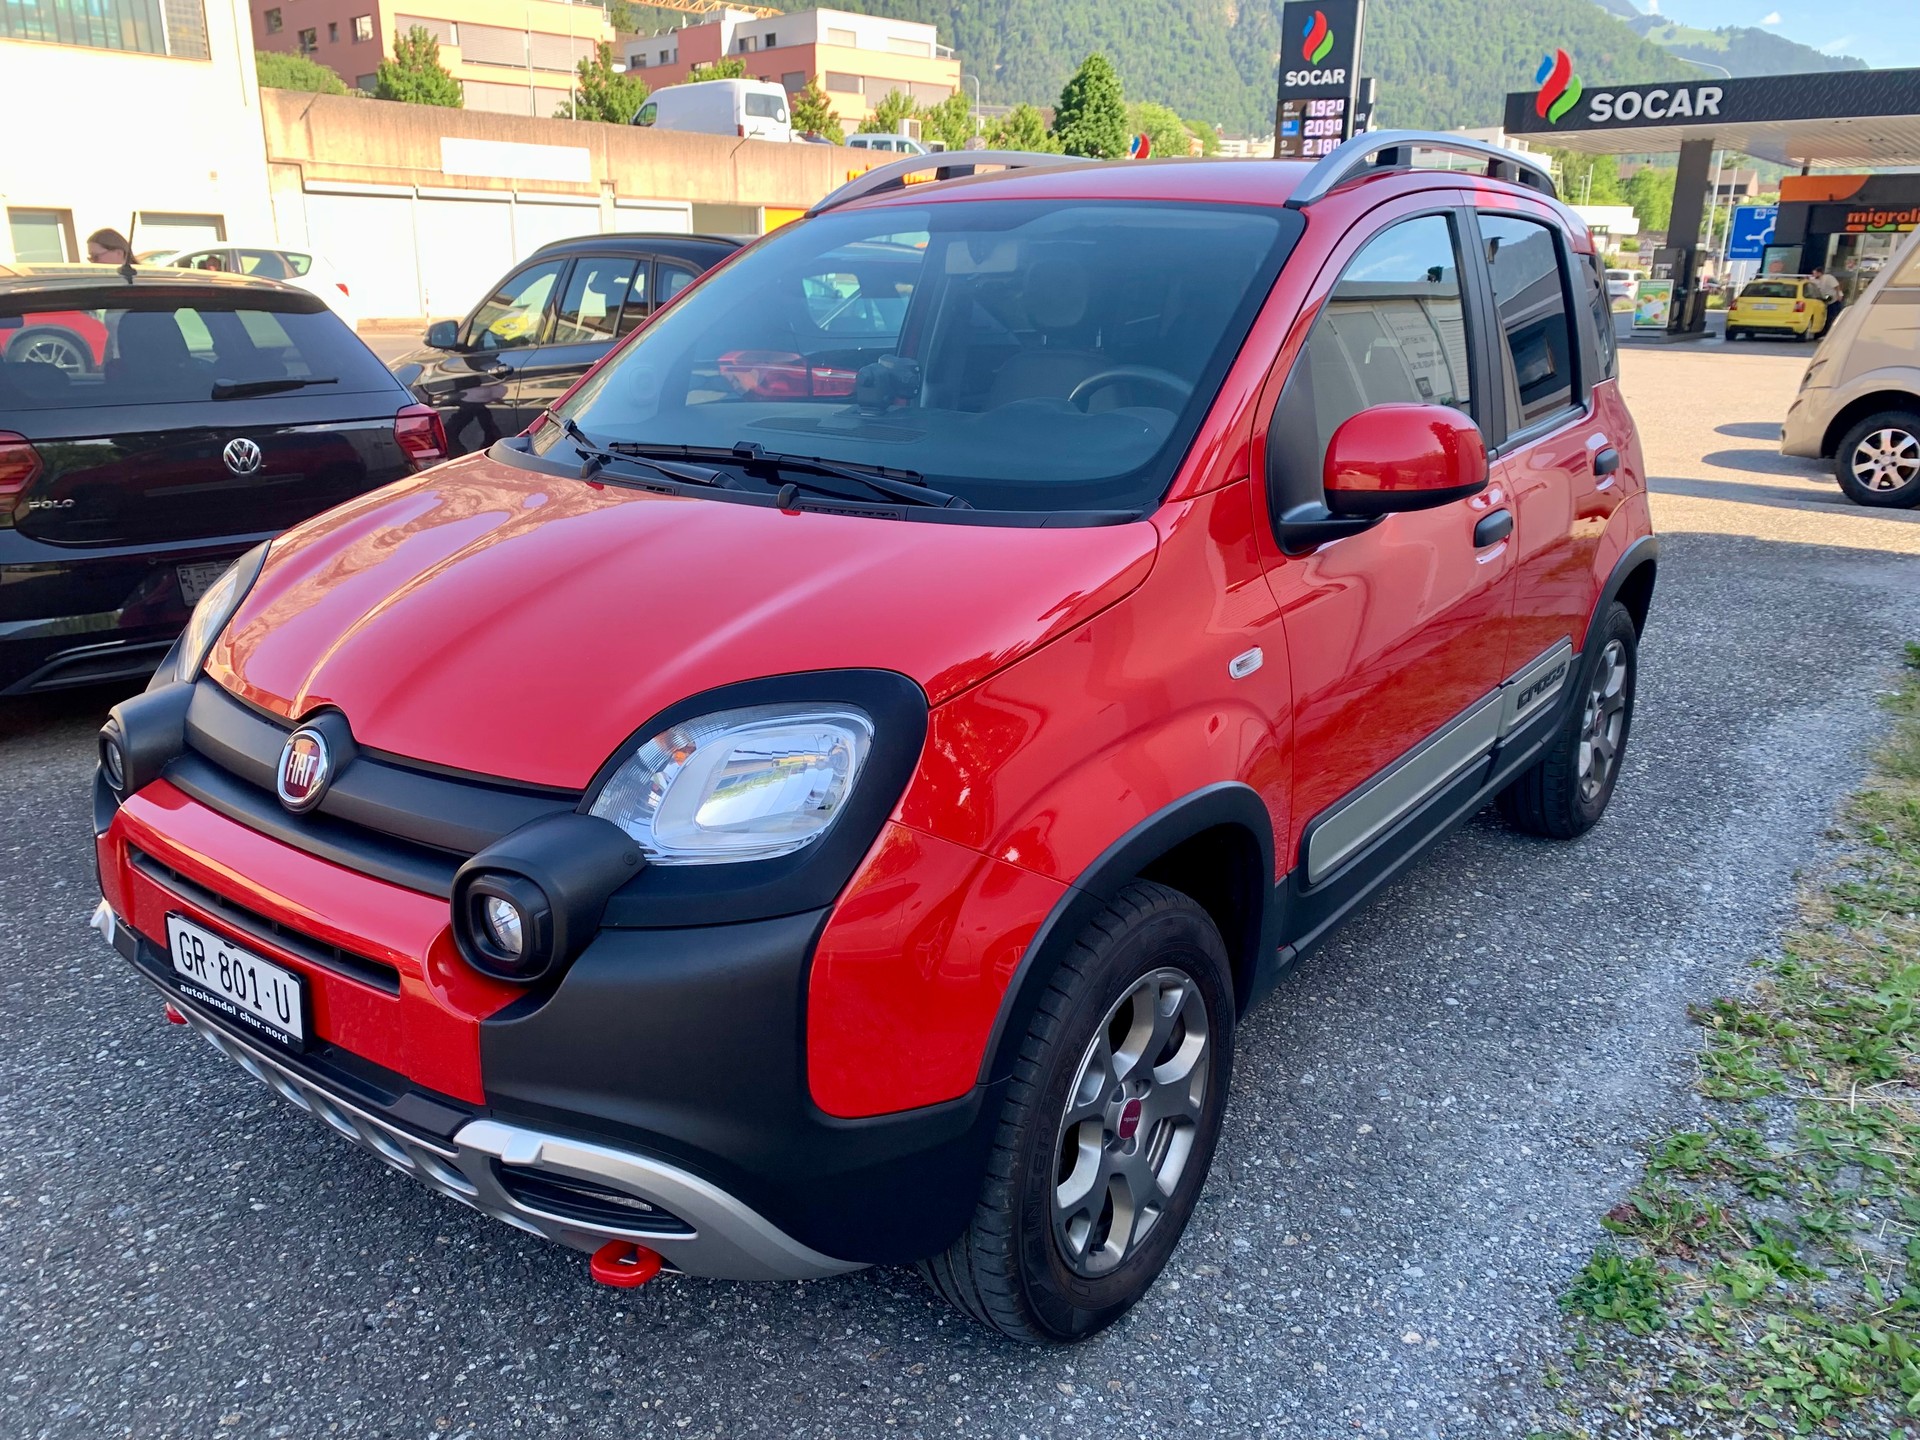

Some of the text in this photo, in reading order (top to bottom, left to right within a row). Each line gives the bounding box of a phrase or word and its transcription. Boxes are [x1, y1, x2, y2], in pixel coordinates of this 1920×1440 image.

[1285, 68, 1346, 87] SOCAR
[1588, 86, 1723, 122] SOCAR
[29, 499, 75, 509] POLO
[286, 750, 317, 788] FIAT
[180, 983, 288, 1045] autohandel chur-nord
